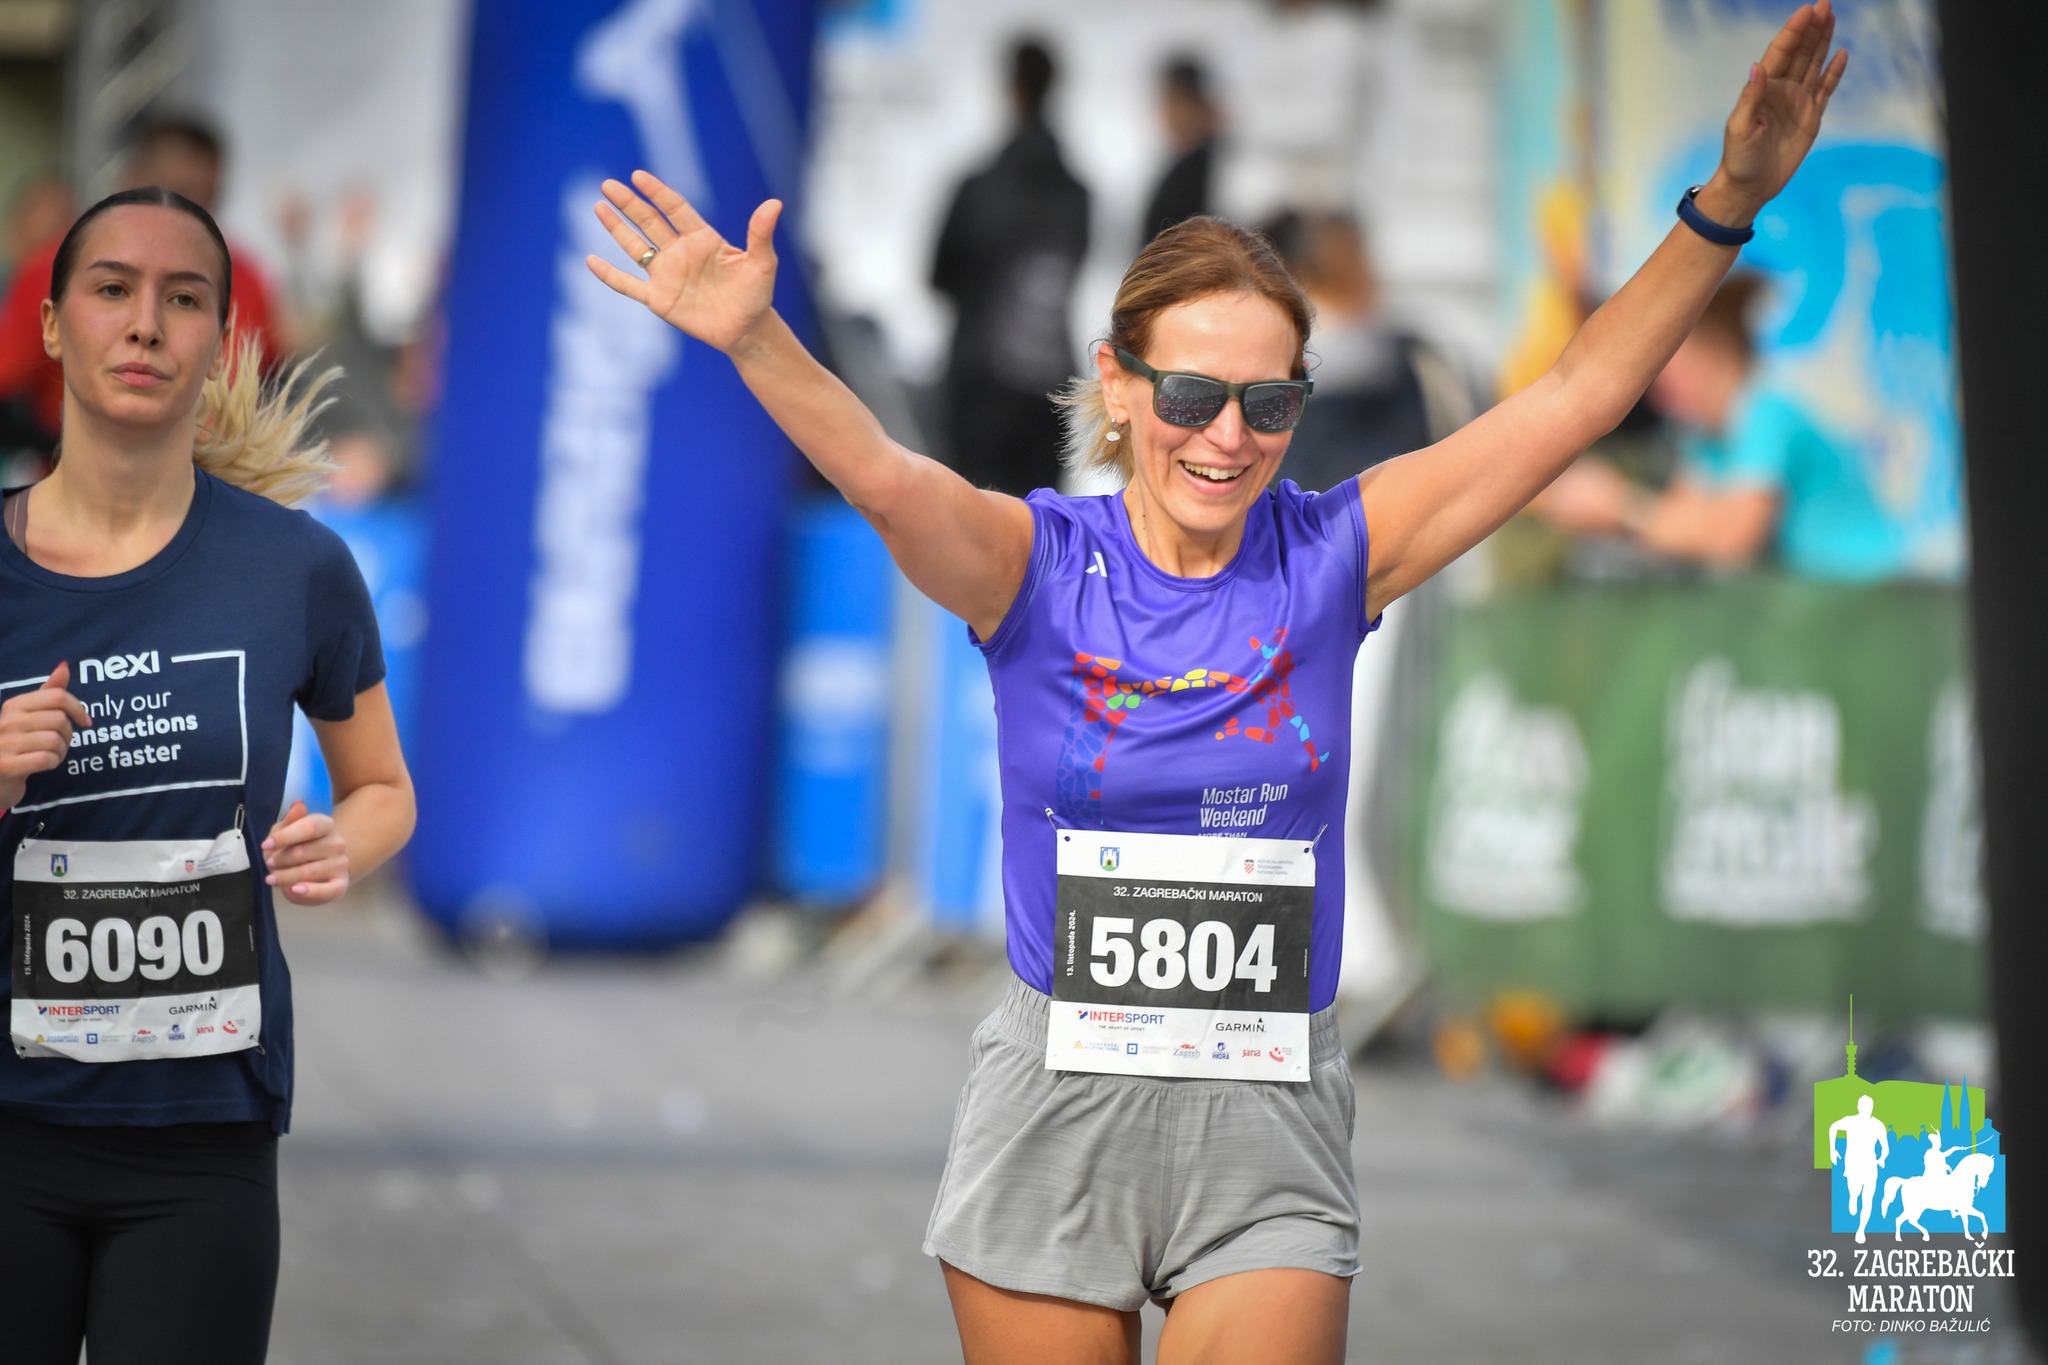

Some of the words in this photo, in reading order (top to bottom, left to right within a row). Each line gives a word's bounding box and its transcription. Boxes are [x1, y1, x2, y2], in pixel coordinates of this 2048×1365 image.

[79, 651, 160, 684] nexi
[130, 692, 171, 712] our
[69, 714, 198, 748] ansactions
[67, 756, 104, 776] are
[108, 744, 182, 769] faster
[1201, 786, 1258, 805] Mostar
[1259, 783, 1289, 803] Run
[1200, 804, 1268, 828] Weekend
[63, 889, 80, 900] 32.
[150, 883, 200, 899] MARATON
[1113, 886, 1131, 897] 32.
[1132, 887, 1207, 901] ZAGREBAČKI
[1208, 890, 1263, 902] MARATON
[1068, 909, 1077, 930] 2024.
[45, 909, 224, 983] 6090
[1066, 931, 1077, 965] listopada
[1089, 916, 1278, 993] 5804
[1066, 965, 1074, 976] 13.
[48, 1005, 120, 1016] INTERSPORT
[168, 1002, 218, 1015] GARMIN
[1089, 1010, 1165, 1024] INTERSPORT
[1215, 1022, 1265, 1033] GARMIN
